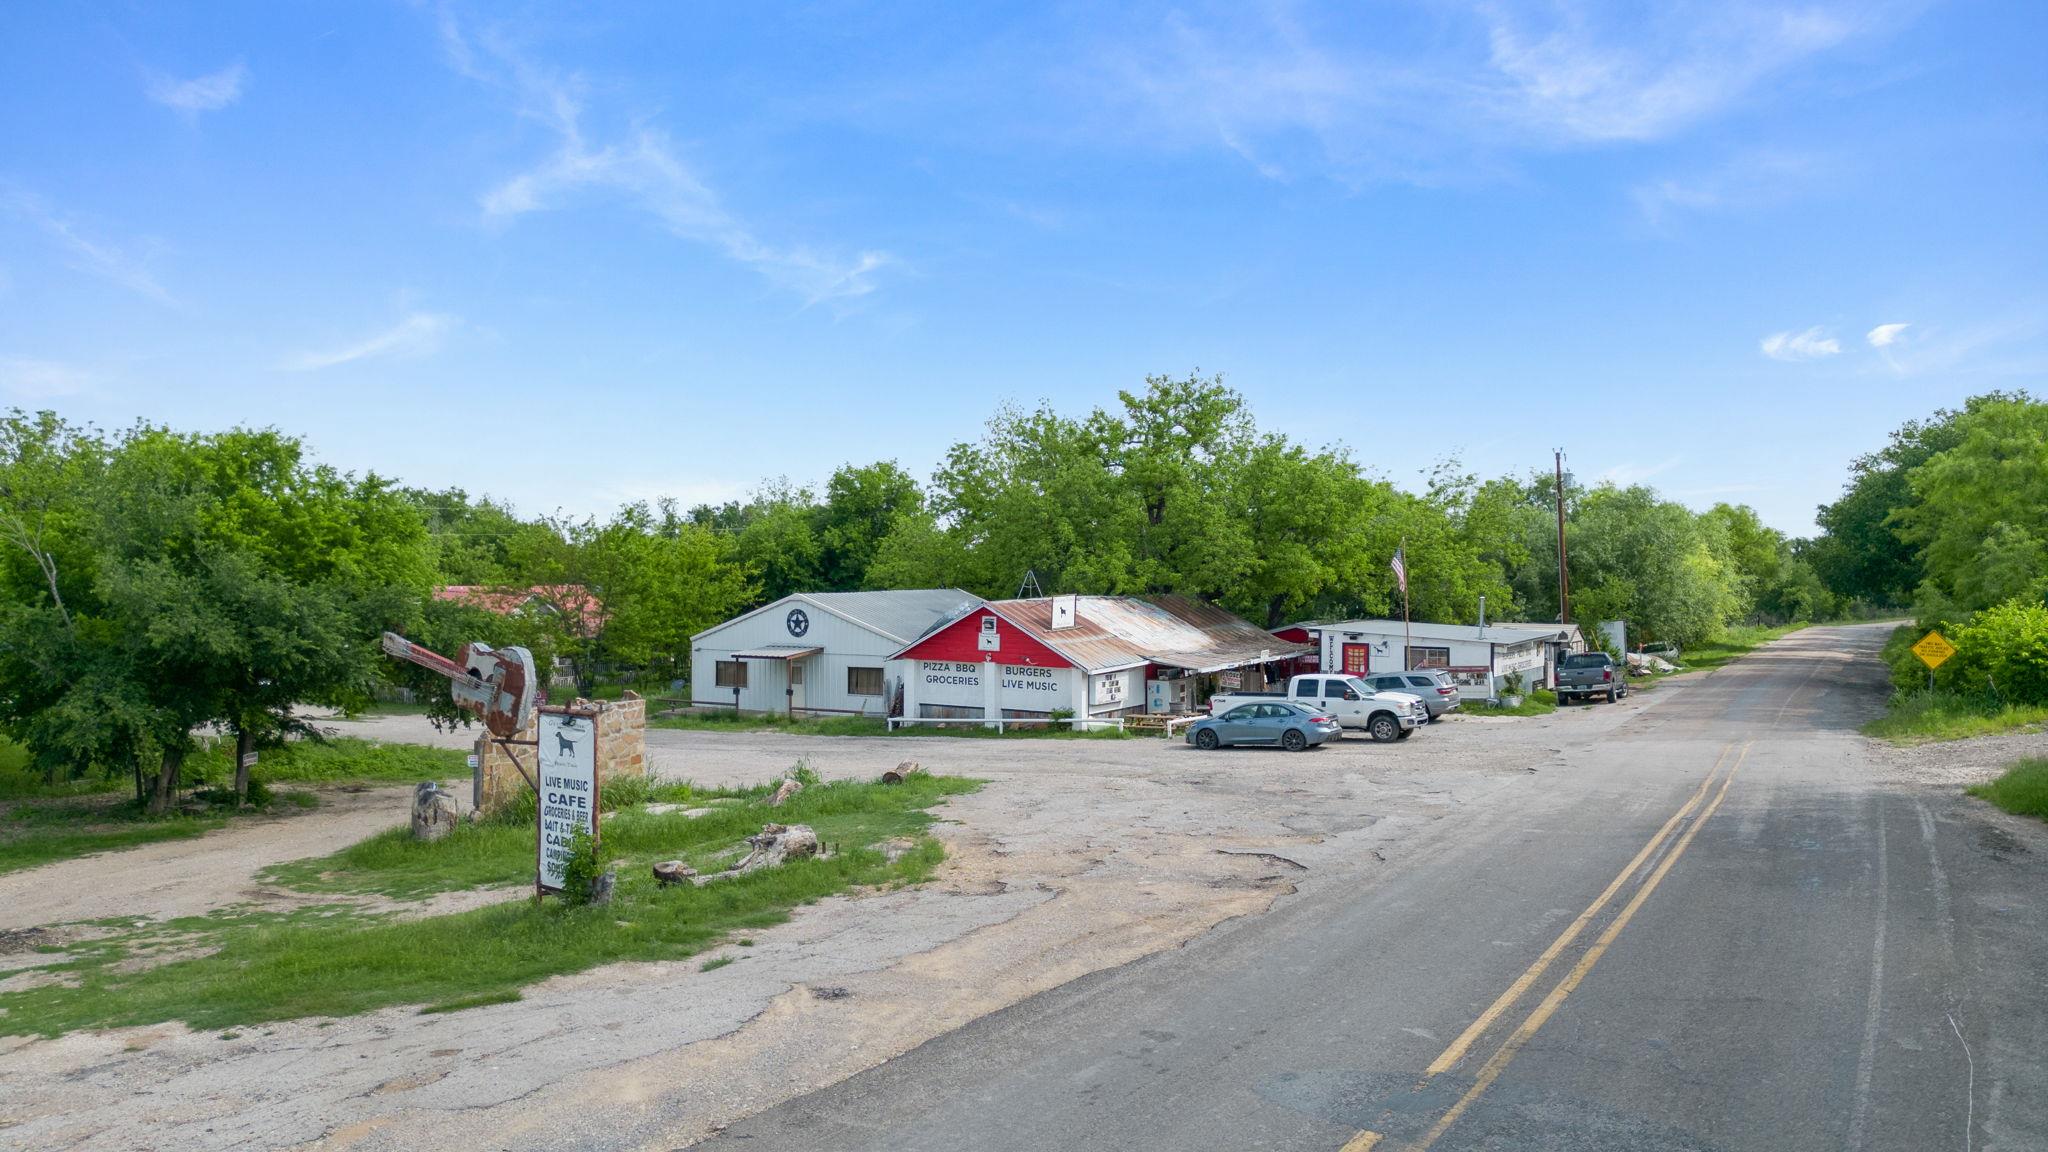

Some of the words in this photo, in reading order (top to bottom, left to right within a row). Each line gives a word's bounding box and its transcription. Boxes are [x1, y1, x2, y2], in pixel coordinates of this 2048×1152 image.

[923, 662, 951, 672] PIZZA
[955, 663, 976, 673] BBQ
[1005, 666, 1052, 678] BURGERS
[925, 675, 979, 686] GROCERIES
[1002, 679, 1024, 689] LIVE
[1026, 681, 1058, 692] MUSIC
[545, 776, 562, 788] LIVE
[563, 778, 589, 792] MUSIC
[548, 792, 587, 809] CAFE
[544, 805, 571, 820] GROCERIES
[576, 810, 589, 823] BEER
[544, 818, 559, 832] BAIT
